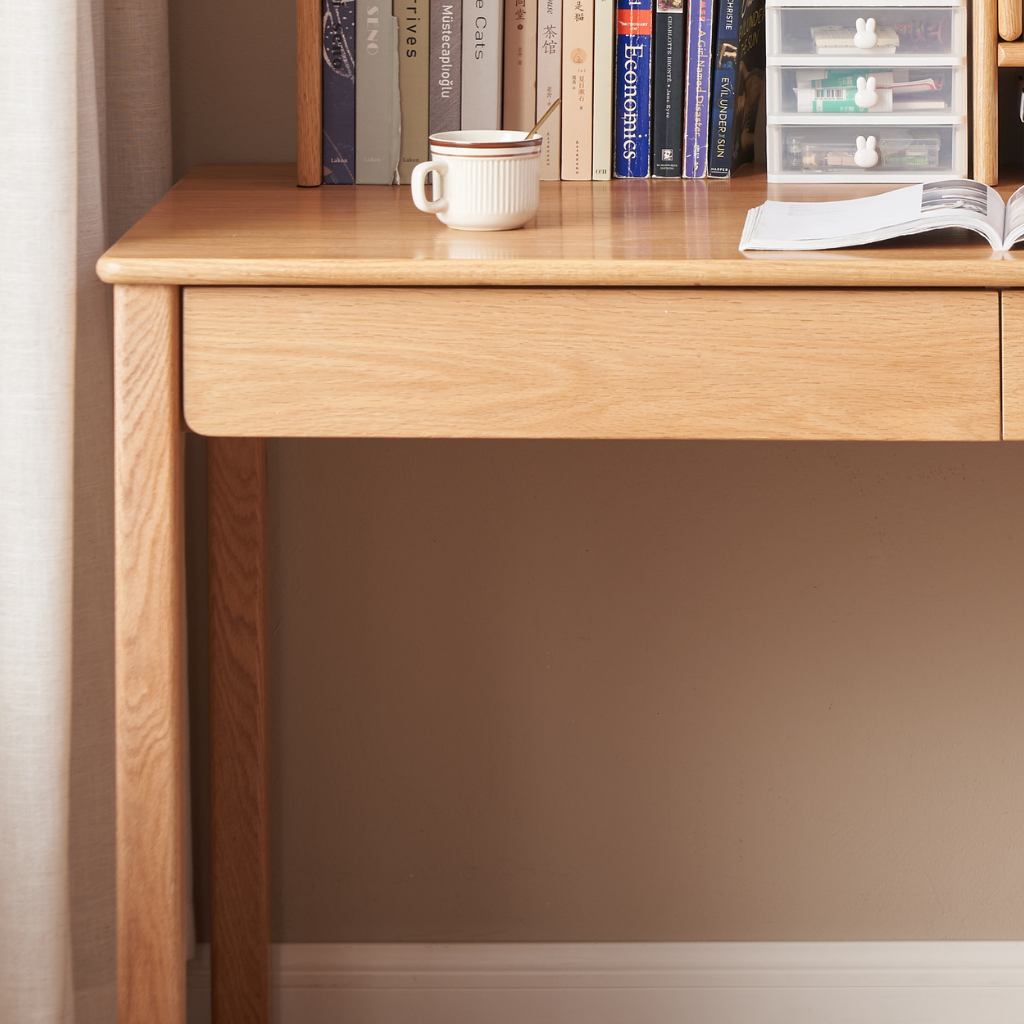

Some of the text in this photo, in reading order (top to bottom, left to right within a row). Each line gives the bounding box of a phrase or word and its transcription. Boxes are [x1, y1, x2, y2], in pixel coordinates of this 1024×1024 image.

[366, 5, 380, 56] SENO
[474, 16, 488, 60] Cats
[542, 24, 557, 55] 茶馆
[698, 29, 706, 38] A
[697, 40, 708, 57] Girl
[696, 60, 707, 92] Named
[721, 77, 730, 97] EVIL
[623, 43, 644, 160] Economics
[694, 95, 705, 137] Disaster
[718, 99, 729, 133] UNDER
[716, 138, 726, 158] SUN
